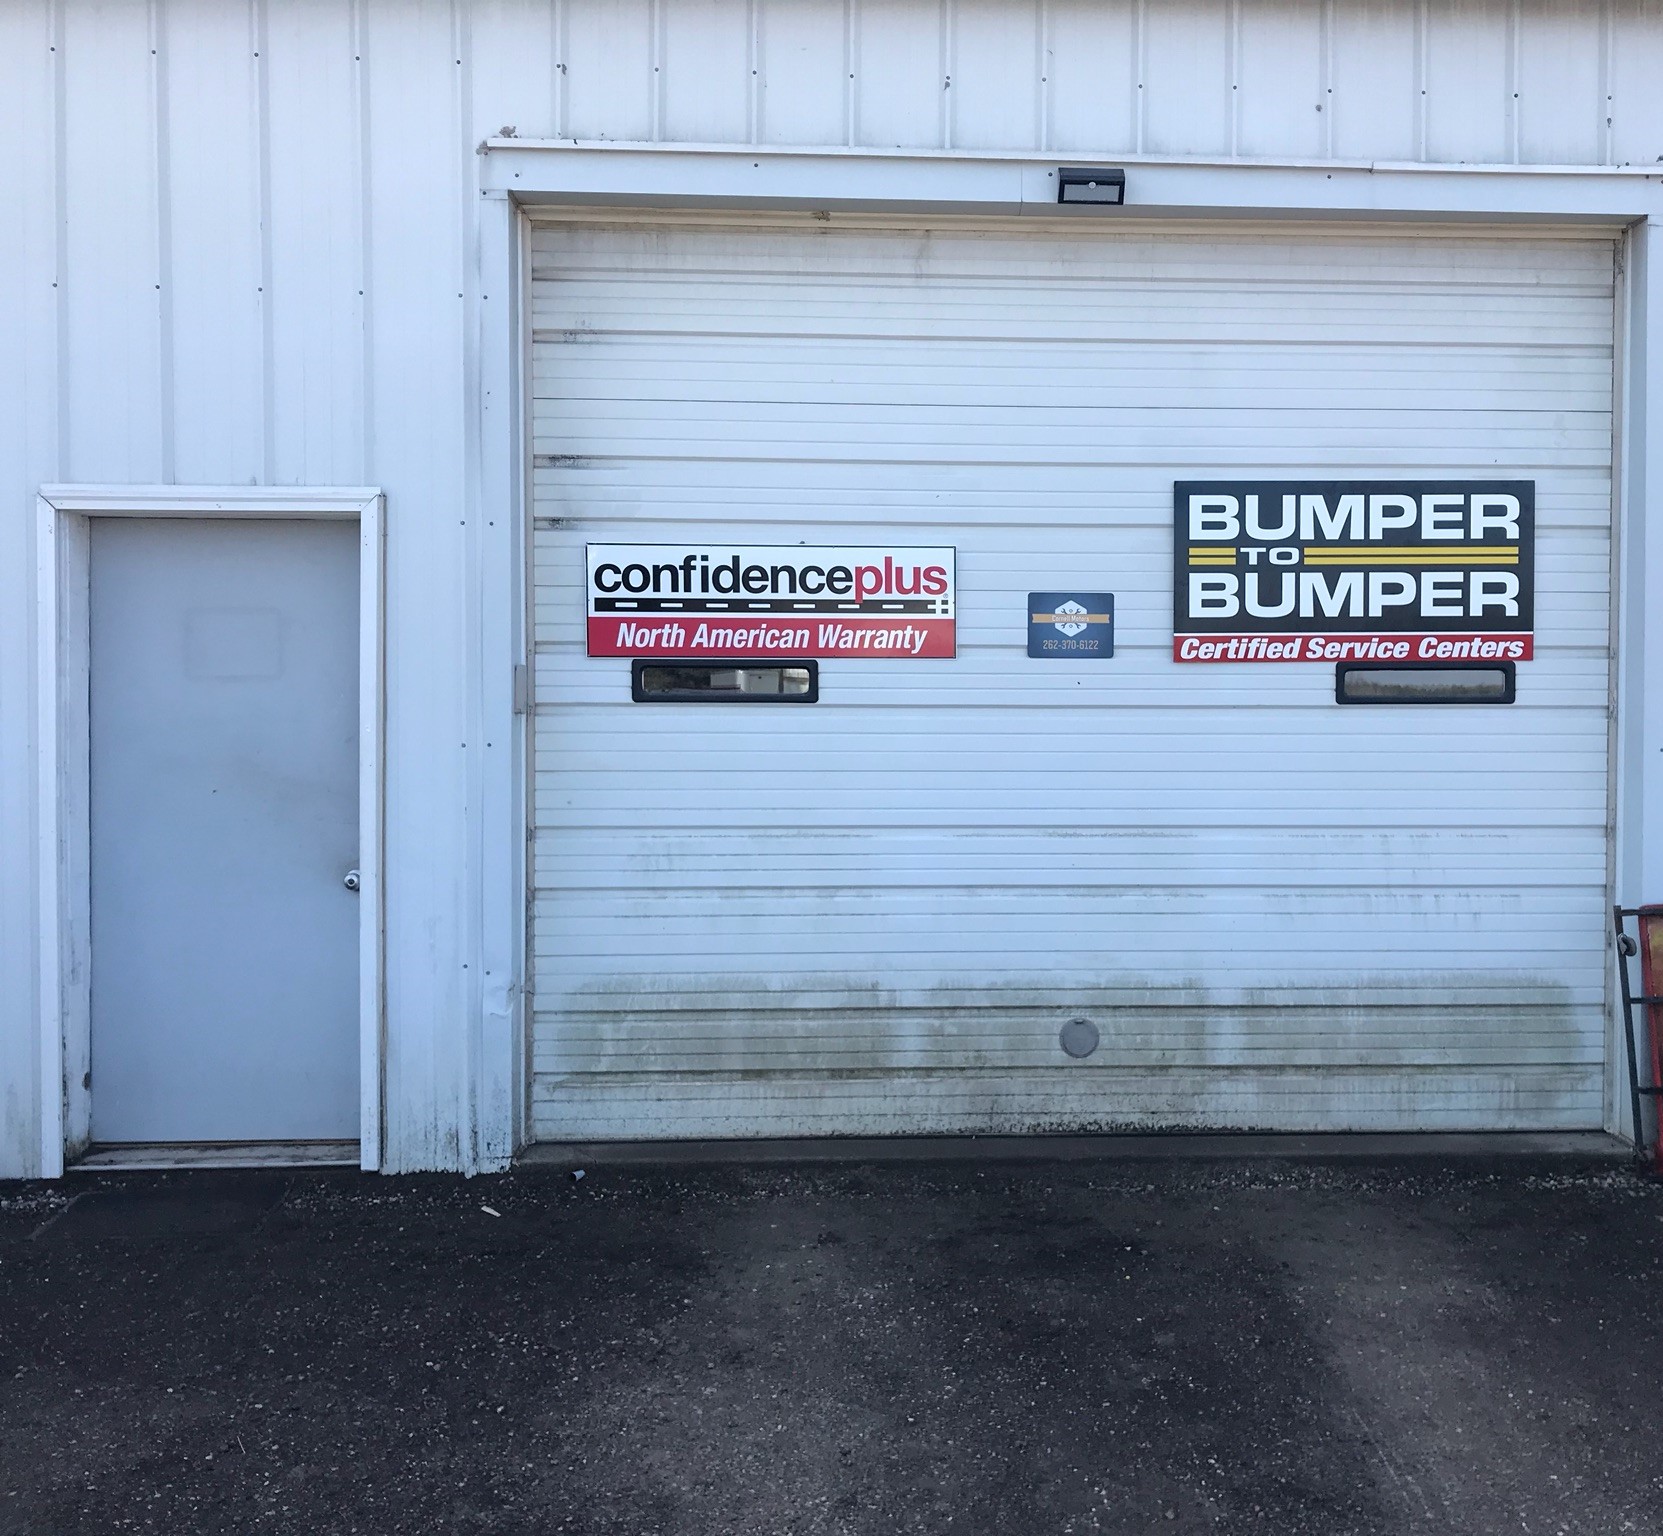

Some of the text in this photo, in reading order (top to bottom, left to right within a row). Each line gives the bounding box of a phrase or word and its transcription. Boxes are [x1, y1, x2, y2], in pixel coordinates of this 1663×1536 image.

[1188, 494, 1520, 540] BUMPER
[1240, 547, 1300, 565] TO
[1188, 571, 1520, 618] BUMPER
[616, 623, 928, 654] North American Warranty
[1042, 640, 1099, 650] 262-370-6122
[1180, 637, 1525, 659] Certified Service Centers
